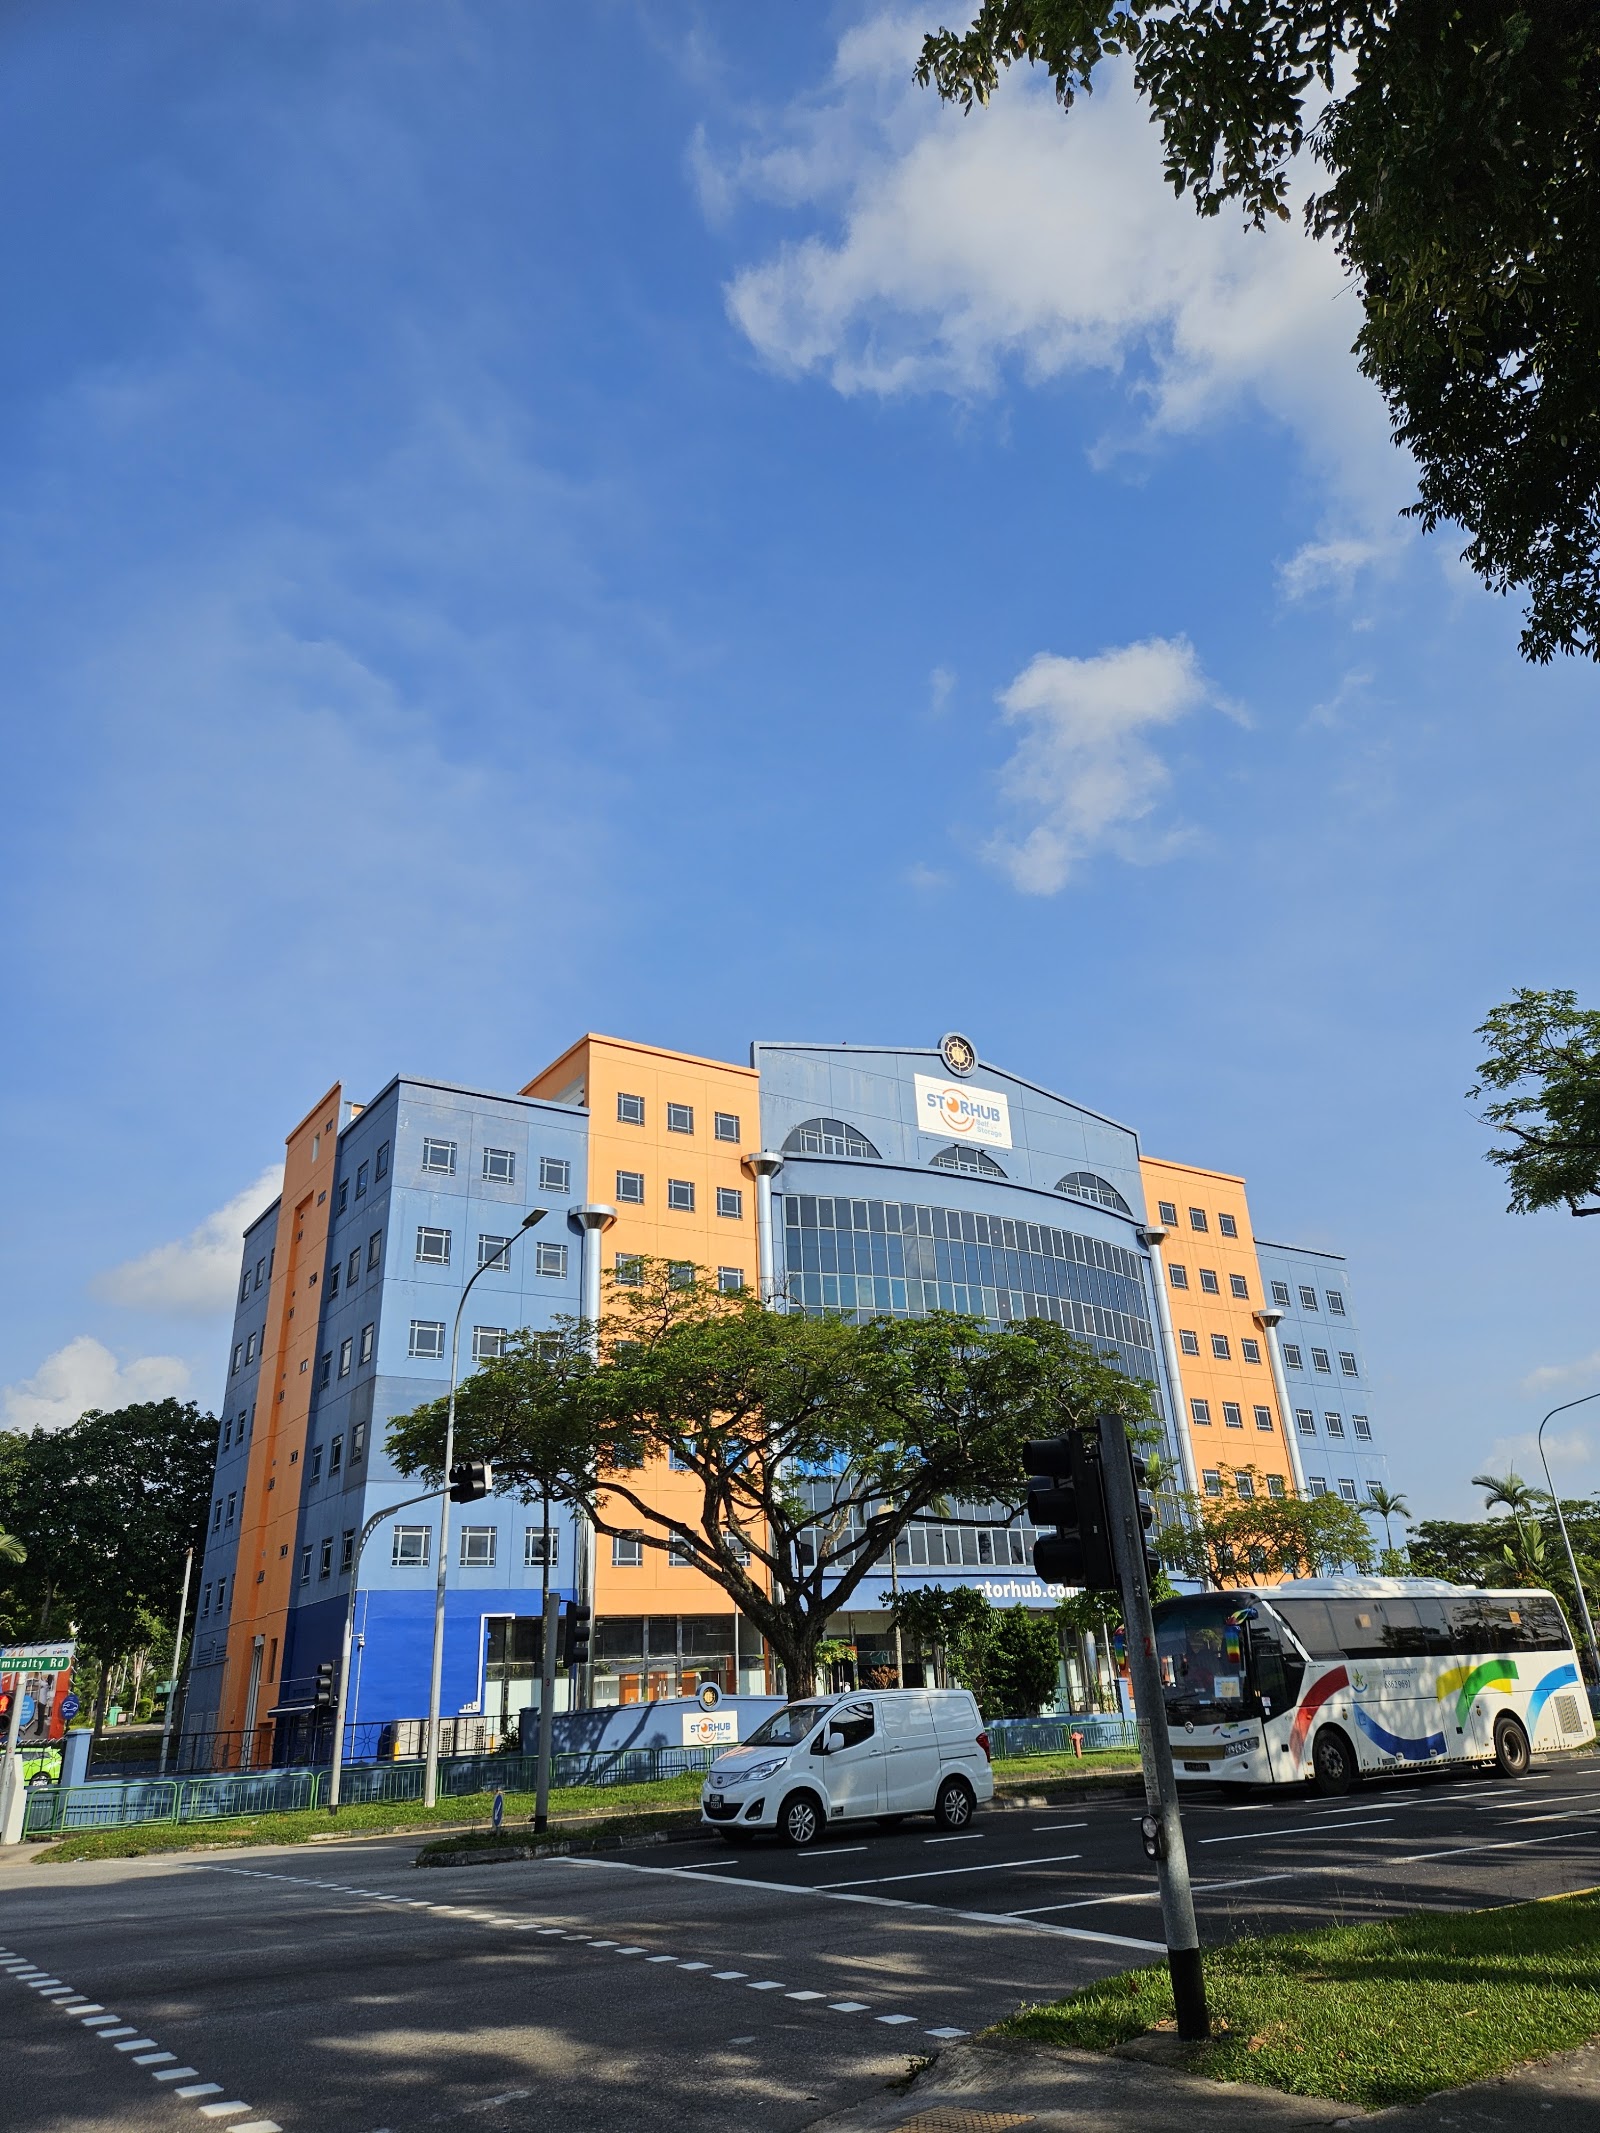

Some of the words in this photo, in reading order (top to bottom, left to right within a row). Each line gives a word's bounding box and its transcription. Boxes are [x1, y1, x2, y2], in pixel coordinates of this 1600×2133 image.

[927, 1093, 1000, 1122] STORHUB
[976, 1119, 989, 1128] Self
[977, 1126, 1002, 1138] Storage
[0, 1658, 44, 1670] miralty
[50, 1657, 65, 1668] Rd
[690, 1722, 731, 1733] STORHUB
